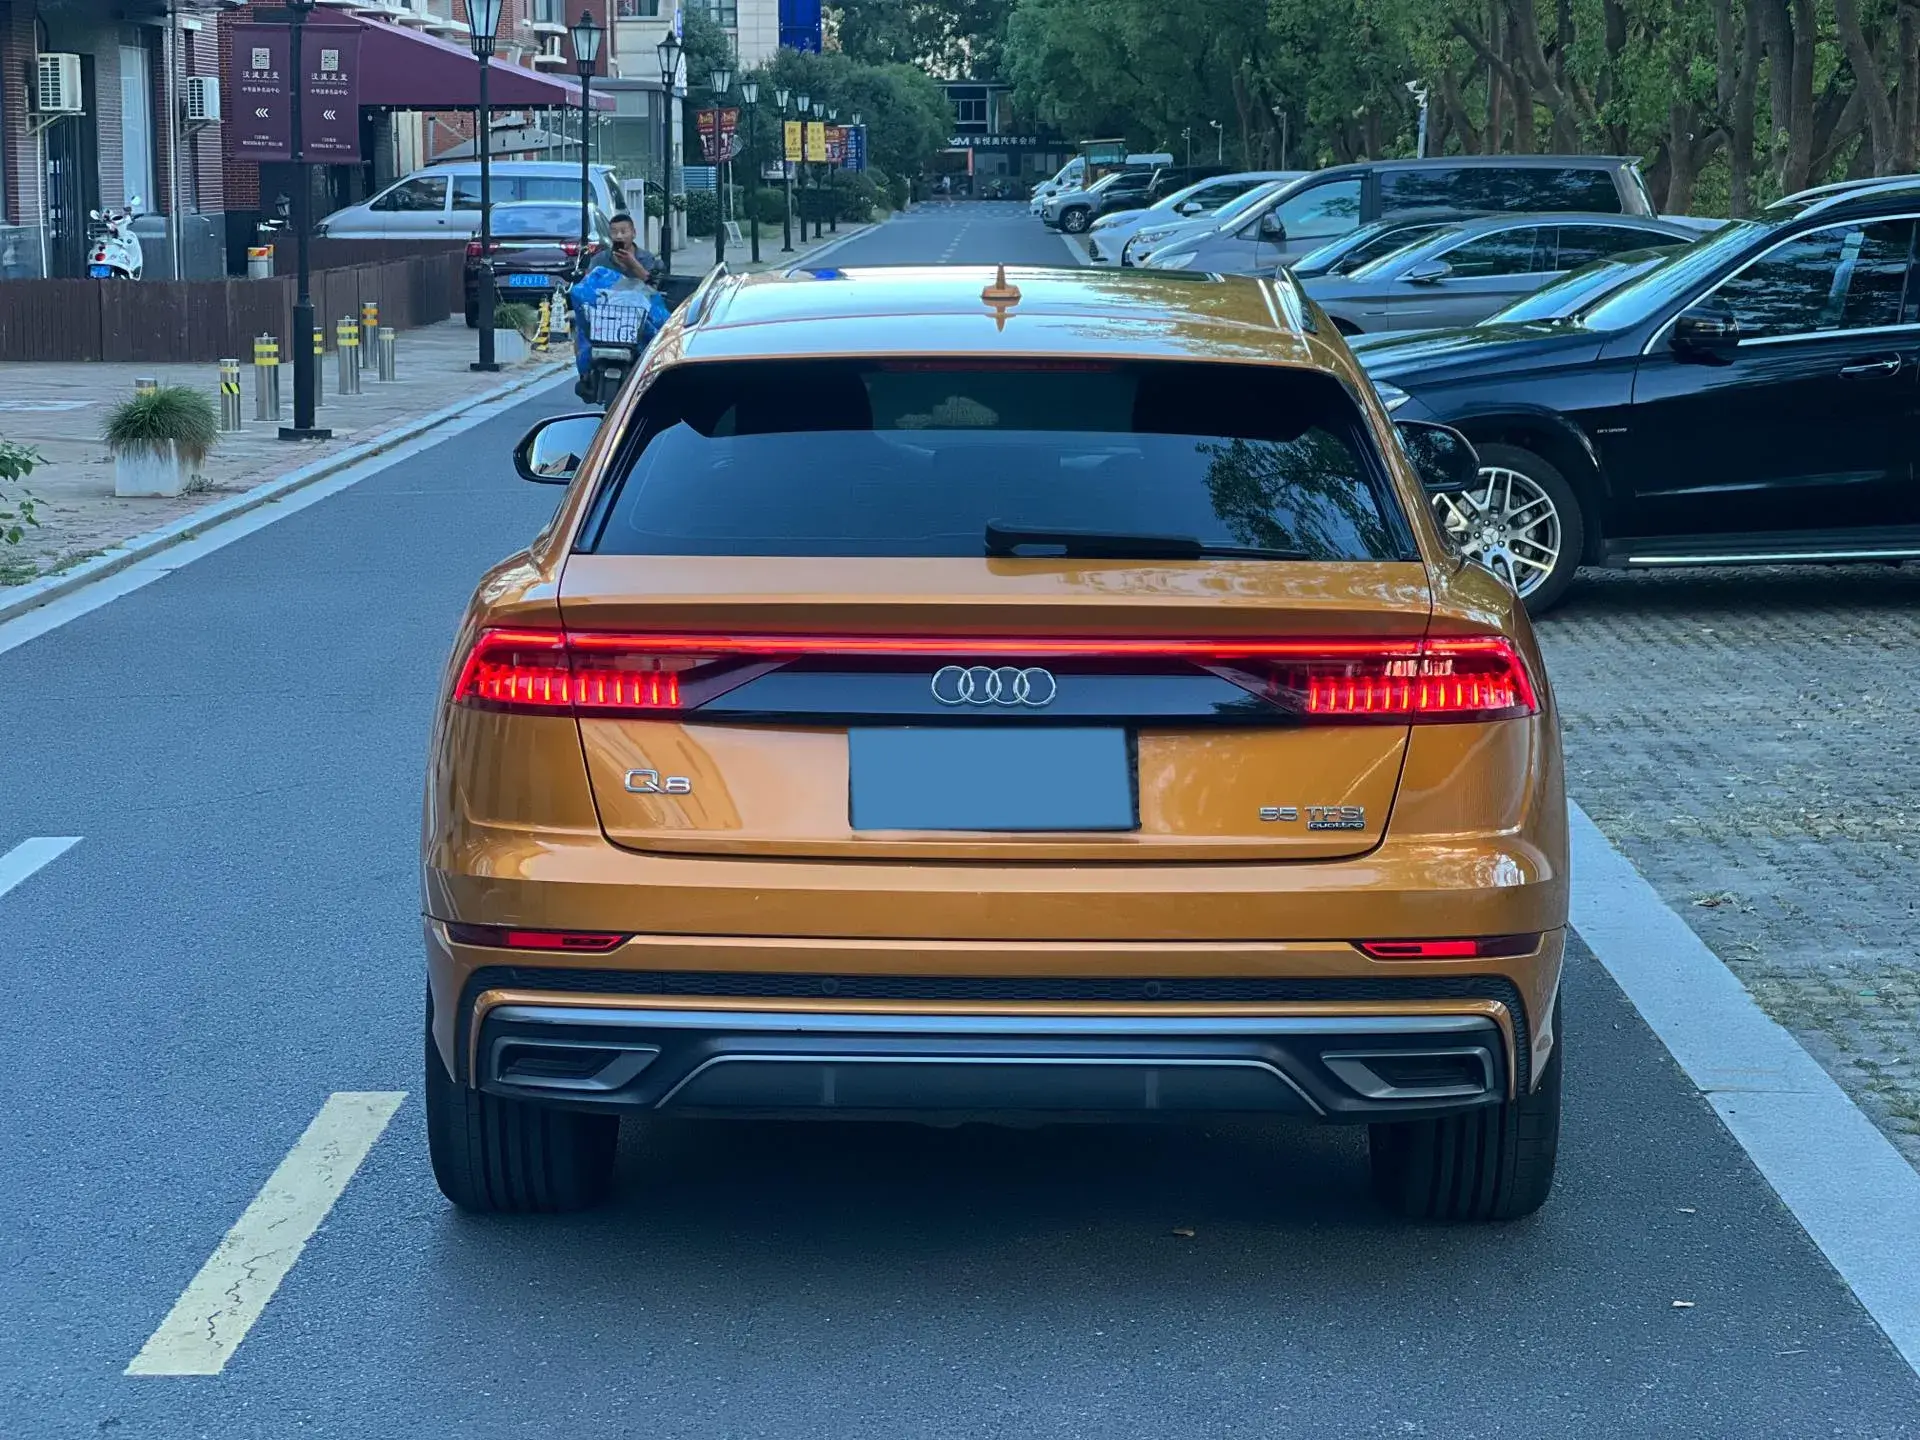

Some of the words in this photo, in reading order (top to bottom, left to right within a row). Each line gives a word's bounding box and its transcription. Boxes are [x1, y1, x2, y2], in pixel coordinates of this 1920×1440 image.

[624, 769, 691, 795] Q8
[1259, 806, 1298, 821] 55
[1303, 806, 1364, 821] TFSI
[1309, 821, 1364, 831] quattro
